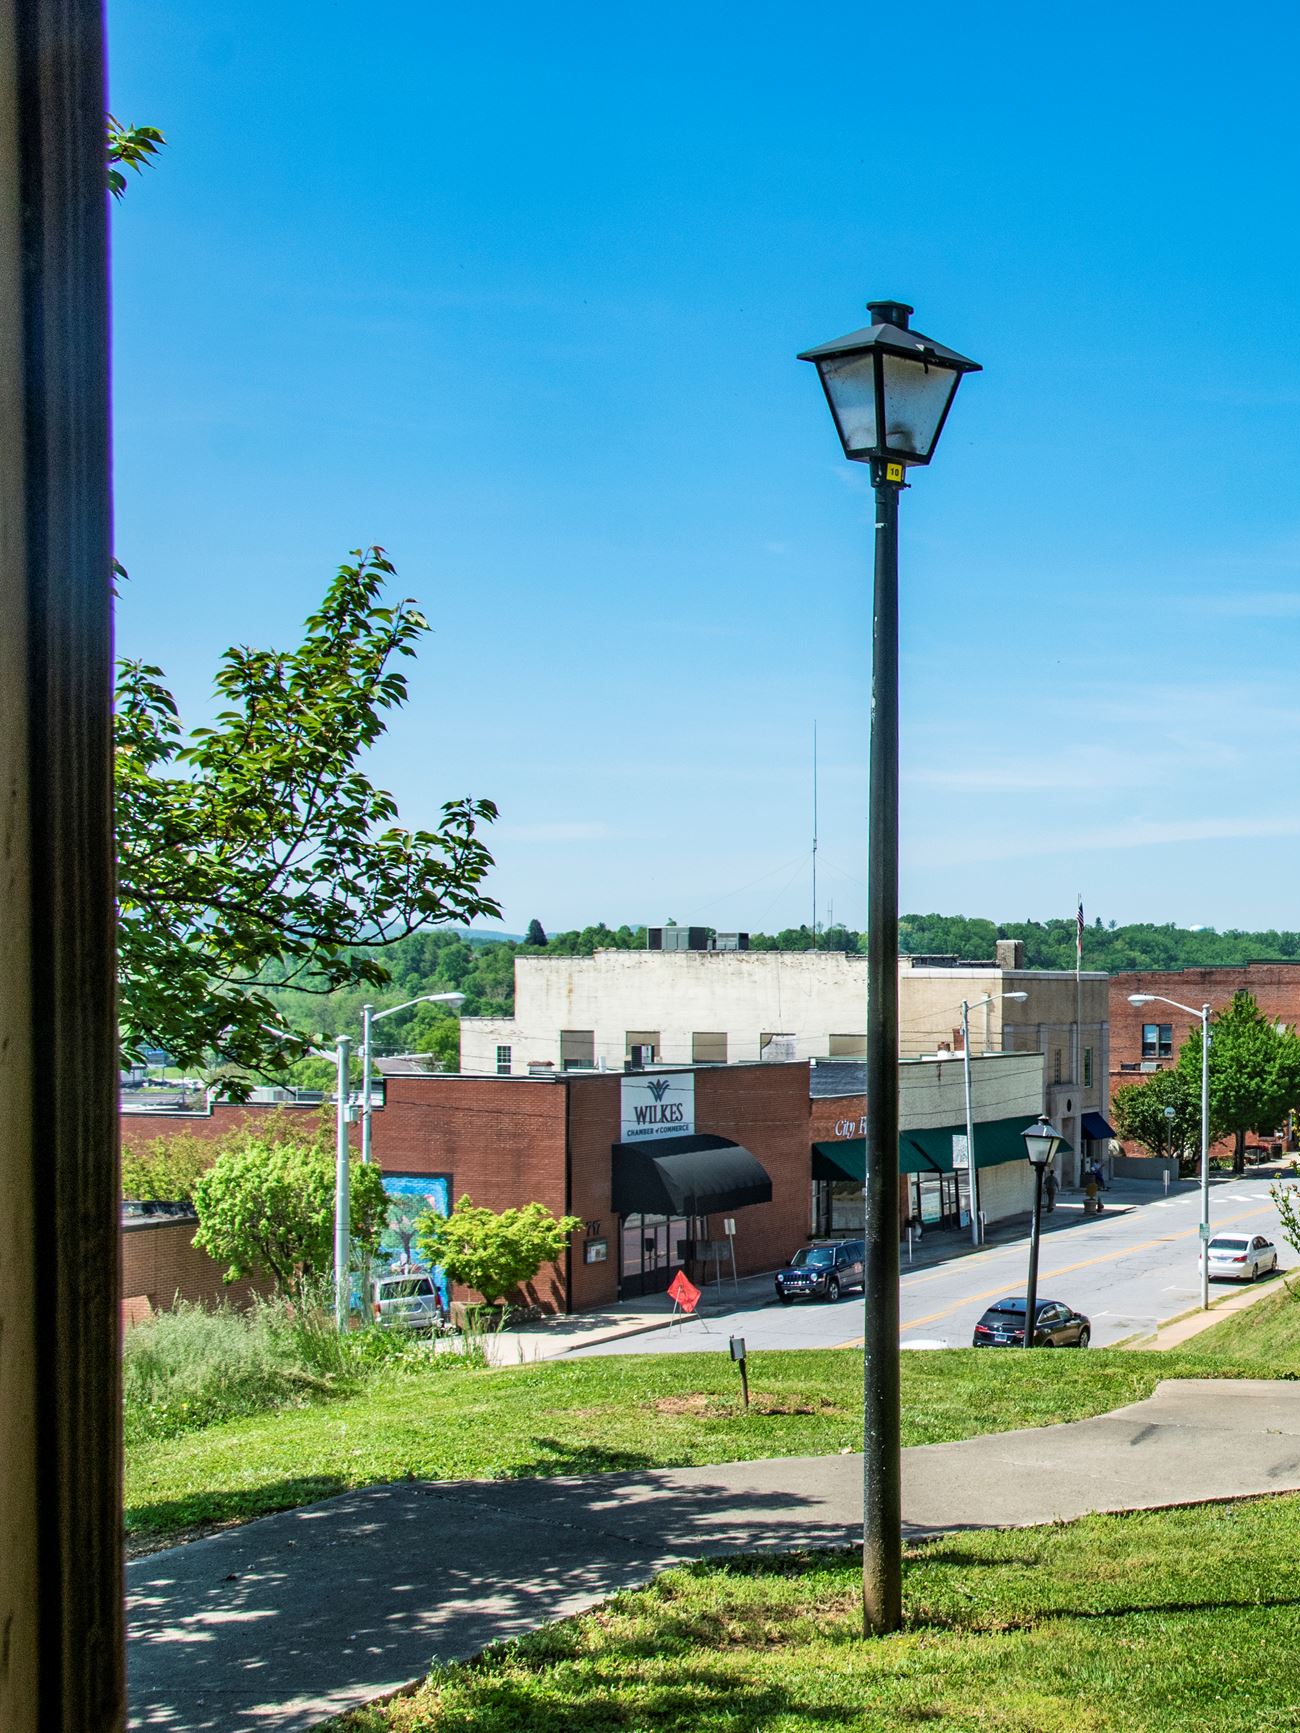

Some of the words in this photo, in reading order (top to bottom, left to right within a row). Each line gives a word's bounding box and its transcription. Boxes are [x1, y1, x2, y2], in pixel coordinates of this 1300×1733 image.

[890, 468, 899, 476] 10
[633, 1103, 683, 1125] WILKES
[627, 1128, 654, 1137] CHAMBER
[660, 1124, 689, 1133] COMMERCE
[835, 1119, 856, 1139] City
